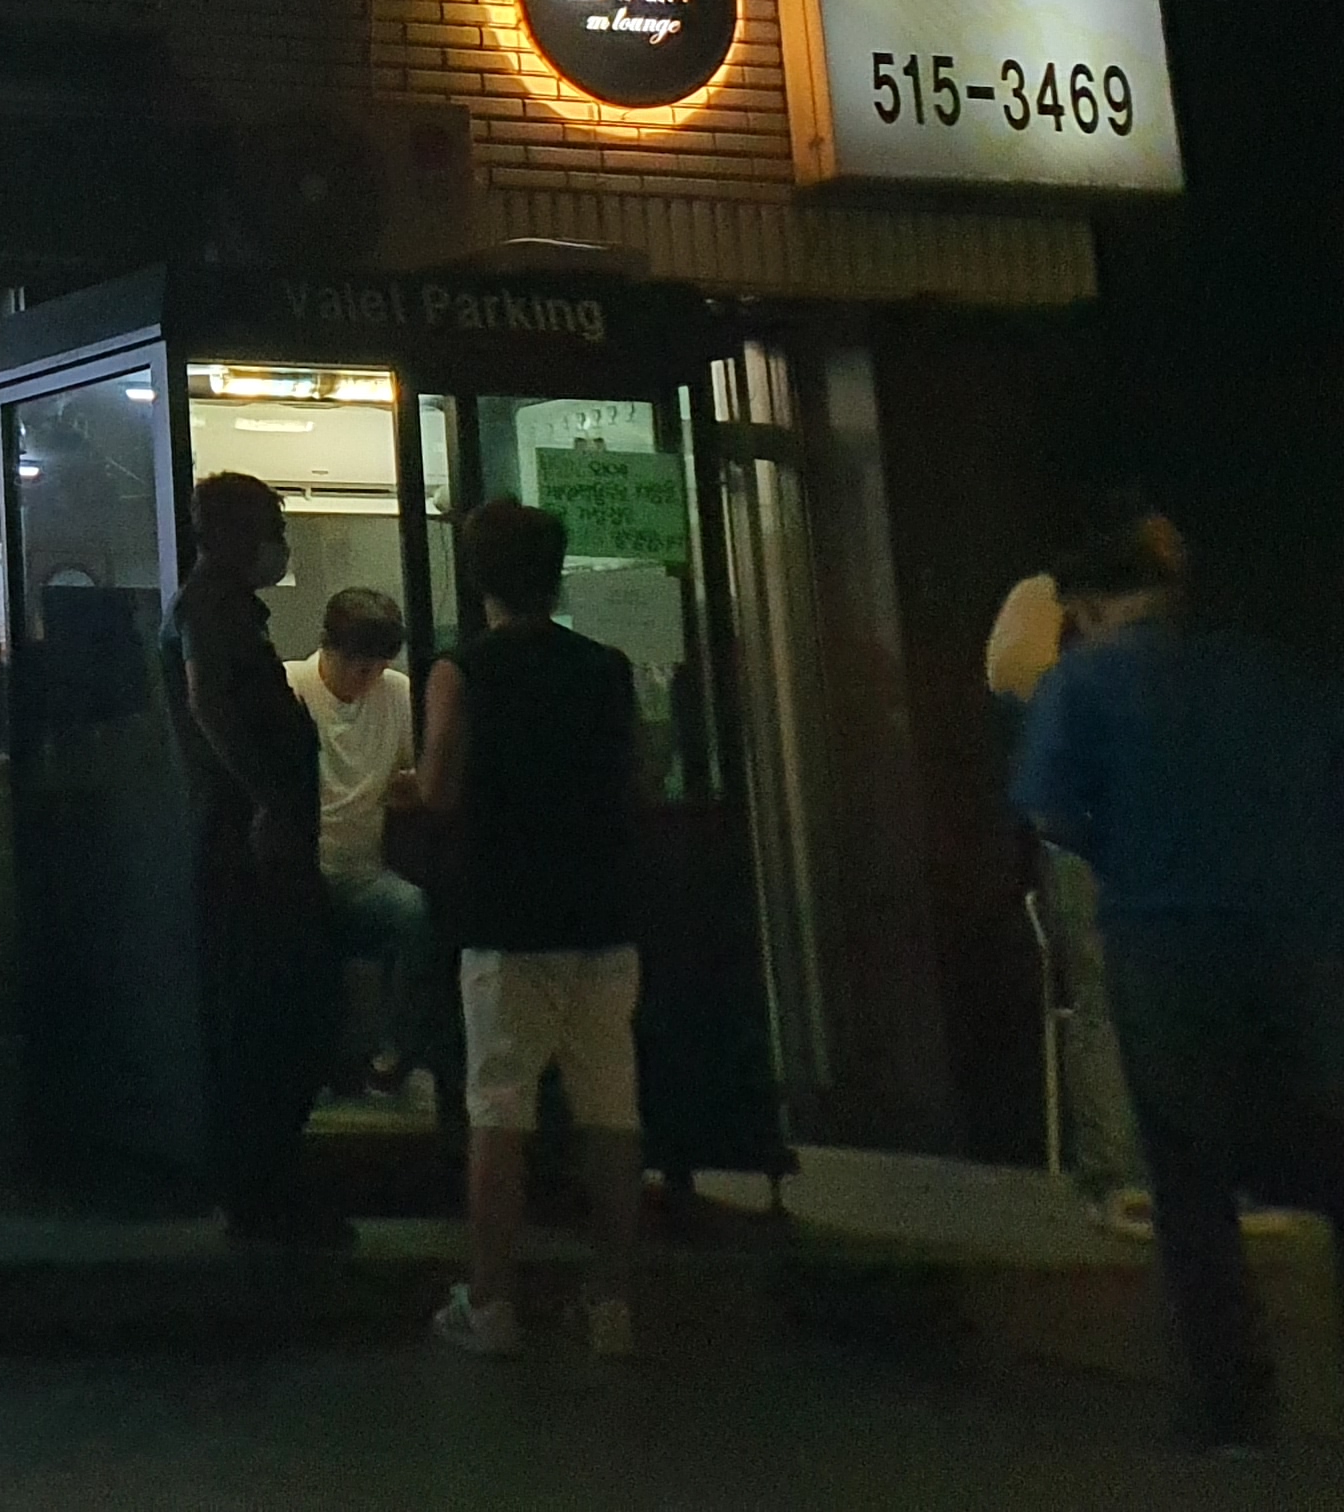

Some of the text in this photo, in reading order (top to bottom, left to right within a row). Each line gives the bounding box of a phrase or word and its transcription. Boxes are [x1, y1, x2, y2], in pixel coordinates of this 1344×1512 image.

[612, 6, 681, 45] lounge
[872, 52, 1133, 136] 515-3469
[283, 279, 605, 341] Valet Parking
